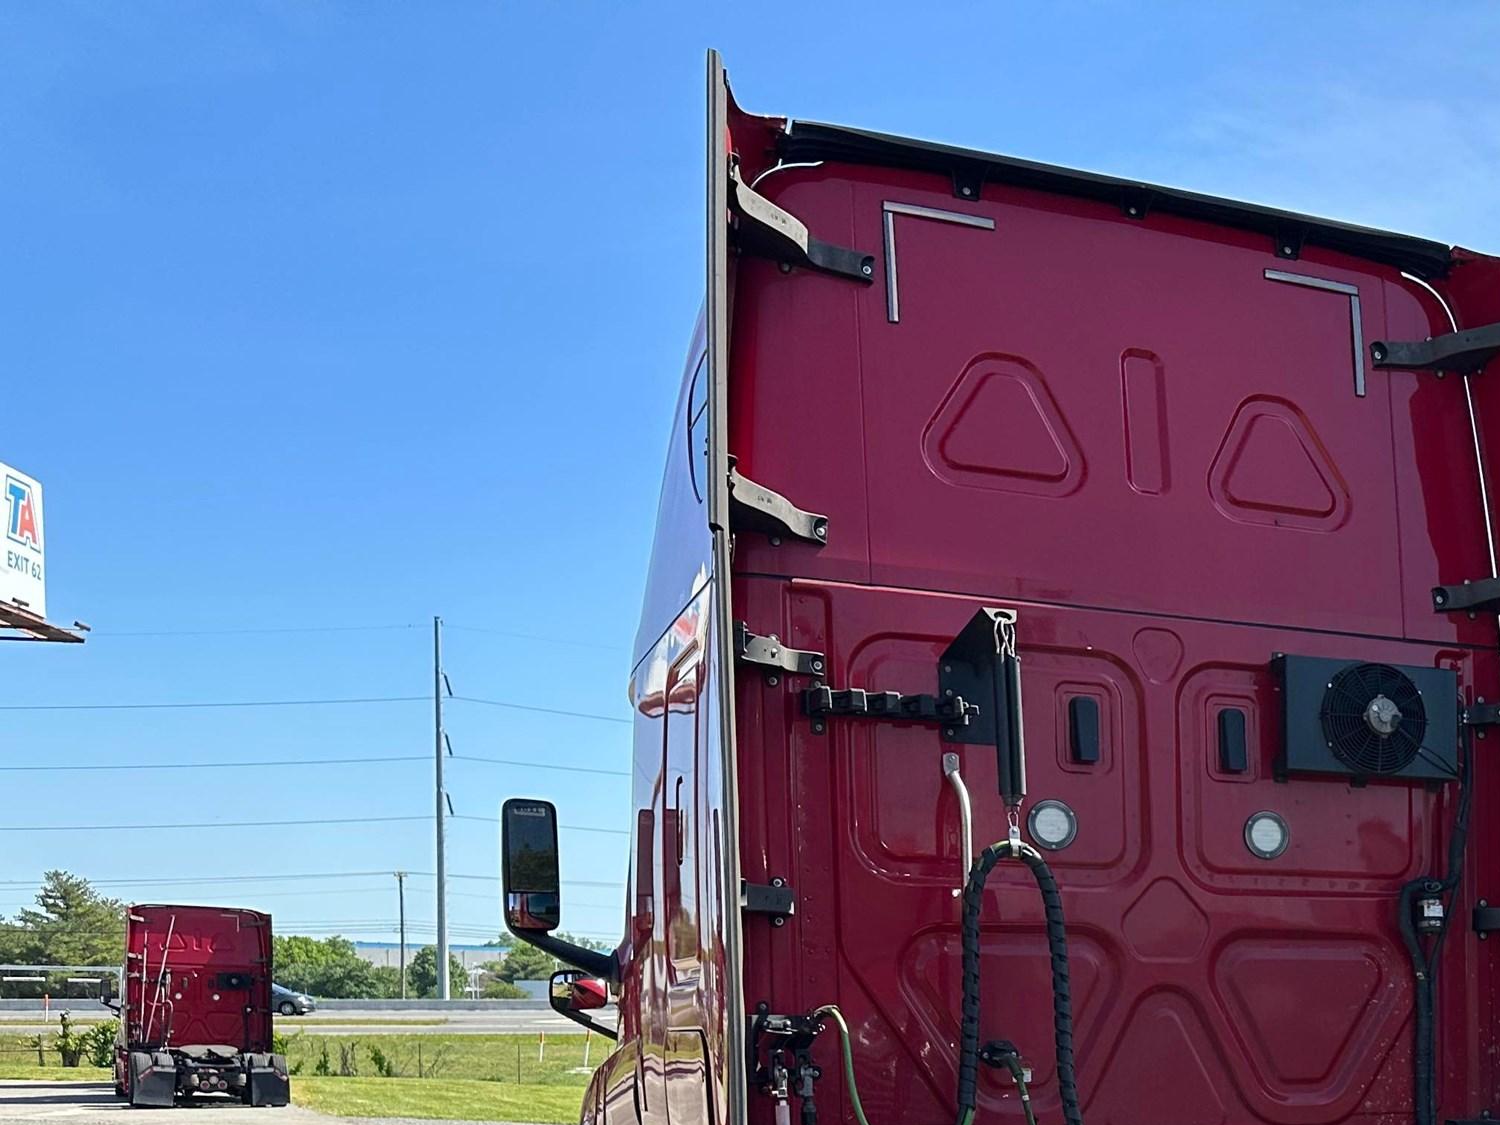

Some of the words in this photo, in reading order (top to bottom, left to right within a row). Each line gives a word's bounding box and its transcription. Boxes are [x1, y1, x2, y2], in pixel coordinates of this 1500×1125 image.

[7, 477, 40, 550] TA
[7, 551, 30, 575] EXIT
[31, 562, 41, 580] 62
